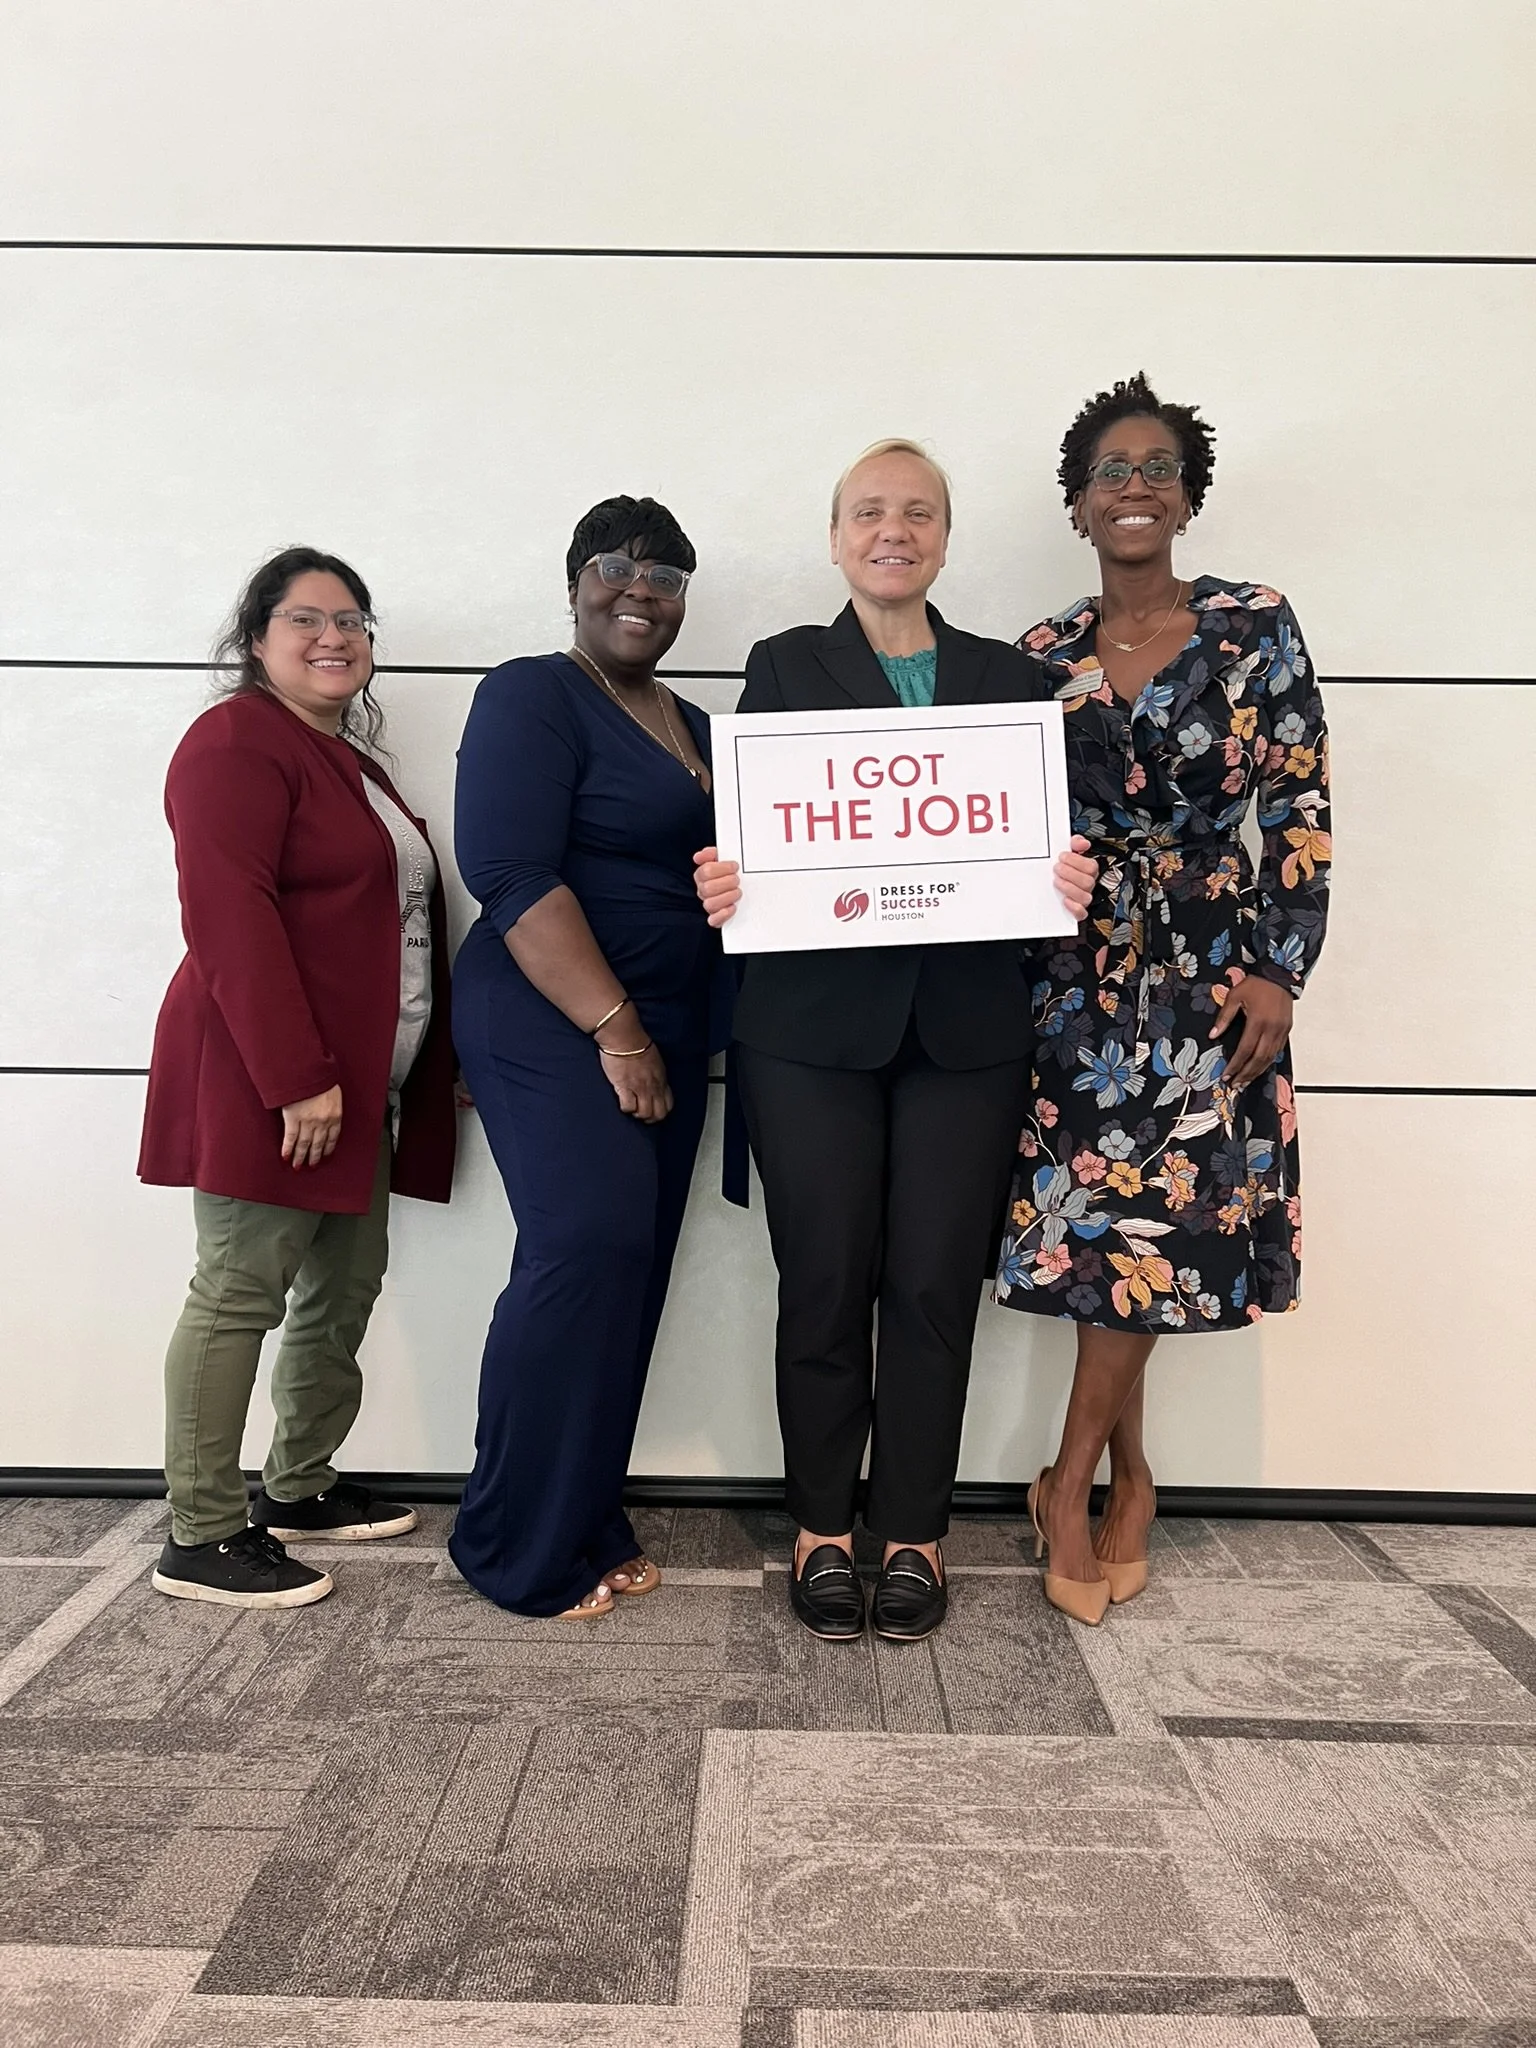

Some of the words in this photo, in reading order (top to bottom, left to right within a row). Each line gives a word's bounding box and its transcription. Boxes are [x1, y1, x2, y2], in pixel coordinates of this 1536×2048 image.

[826, 759, 835, 790] I
[853, 753, 945, 789] GOT
[773, 799, 873, 843] THE
[894, 791, 1010, 838] JOB!
[880, 885, 924, 896] DRESS
[880, 897, 940, 910] SUCCESS
[881, 912, 925, 921] HOUSTON
